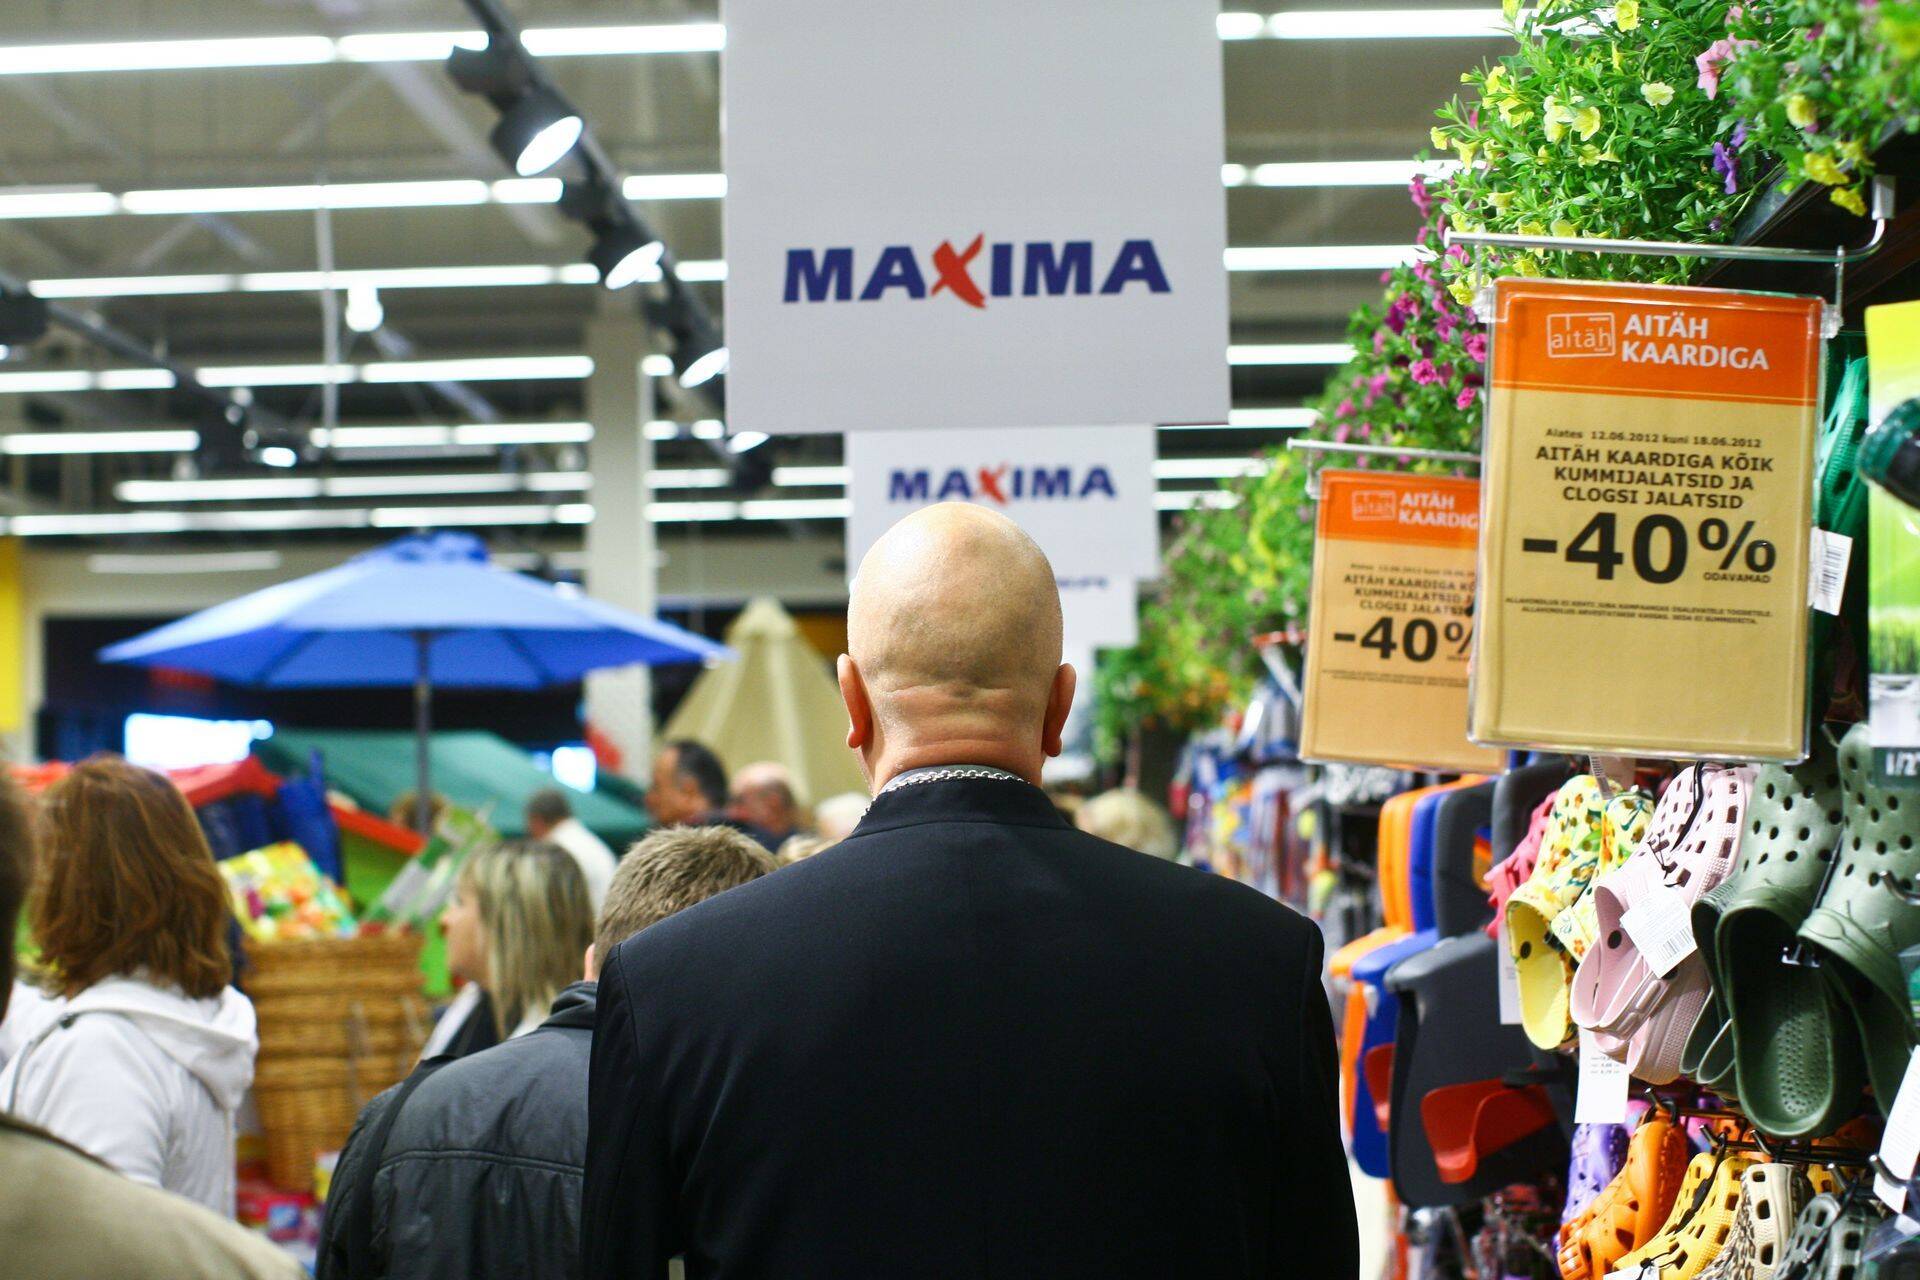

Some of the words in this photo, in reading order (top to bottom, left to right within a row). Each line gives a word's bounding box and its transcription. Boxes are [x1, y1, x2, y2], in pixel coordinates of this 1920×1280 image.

[782, 232, 1172, 310] MAXIMA
[1622, 311, 1708, 339] AITÄH
[1621, 341, 1770, 370] KAARDIGA
[1546, 428, 1583, 439] Alates
[1591, 431, 1659, 443] 12.06.2012
[1662, 434, 1689, 444] kuni
[1693, 436, 1762, 448] 18.06.2012
[1536, 444, 1600, 463] AITÄH
[1607, 449, 1715, 470] KAARDIGA
[1721, 452, 1774, 472] KÕIK
[887, 460, 1117, 506] MAXIMA
[1554, 466, 1724, 489] KUMMIJALATSID
[1730, 476, 1754, 490] JA
[1400, 490, 1455, 510] AITÄH
[1563, 486, 1639, 504] CLOGSI
[1646, 491, 1744, 509] JALATSID
[1399, 509, 1479, 530] KAARDIG
[1522, 511, 1776, 584] -40%
[1703, 571, 1771, 583] ODAVAMAD
